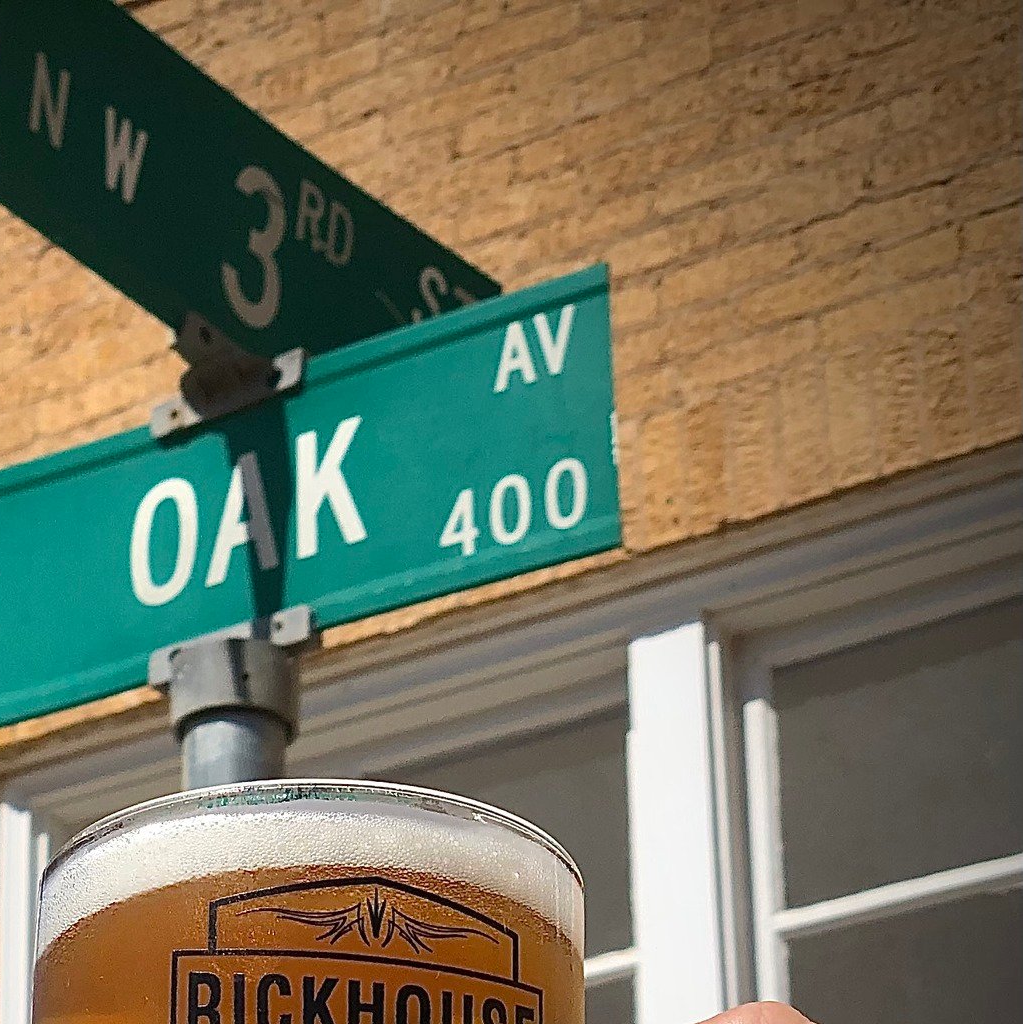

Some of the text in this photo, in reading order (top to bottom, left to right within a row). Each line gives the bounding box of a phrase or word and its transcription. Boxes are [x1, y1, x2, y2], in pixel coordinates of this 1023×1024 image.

[28, 51, 479, 328] N W 3RD S
[129, 415, 367, 606] OAK
[493, 304, 575, 392] AV
[438, 458, 588, 556] 400
